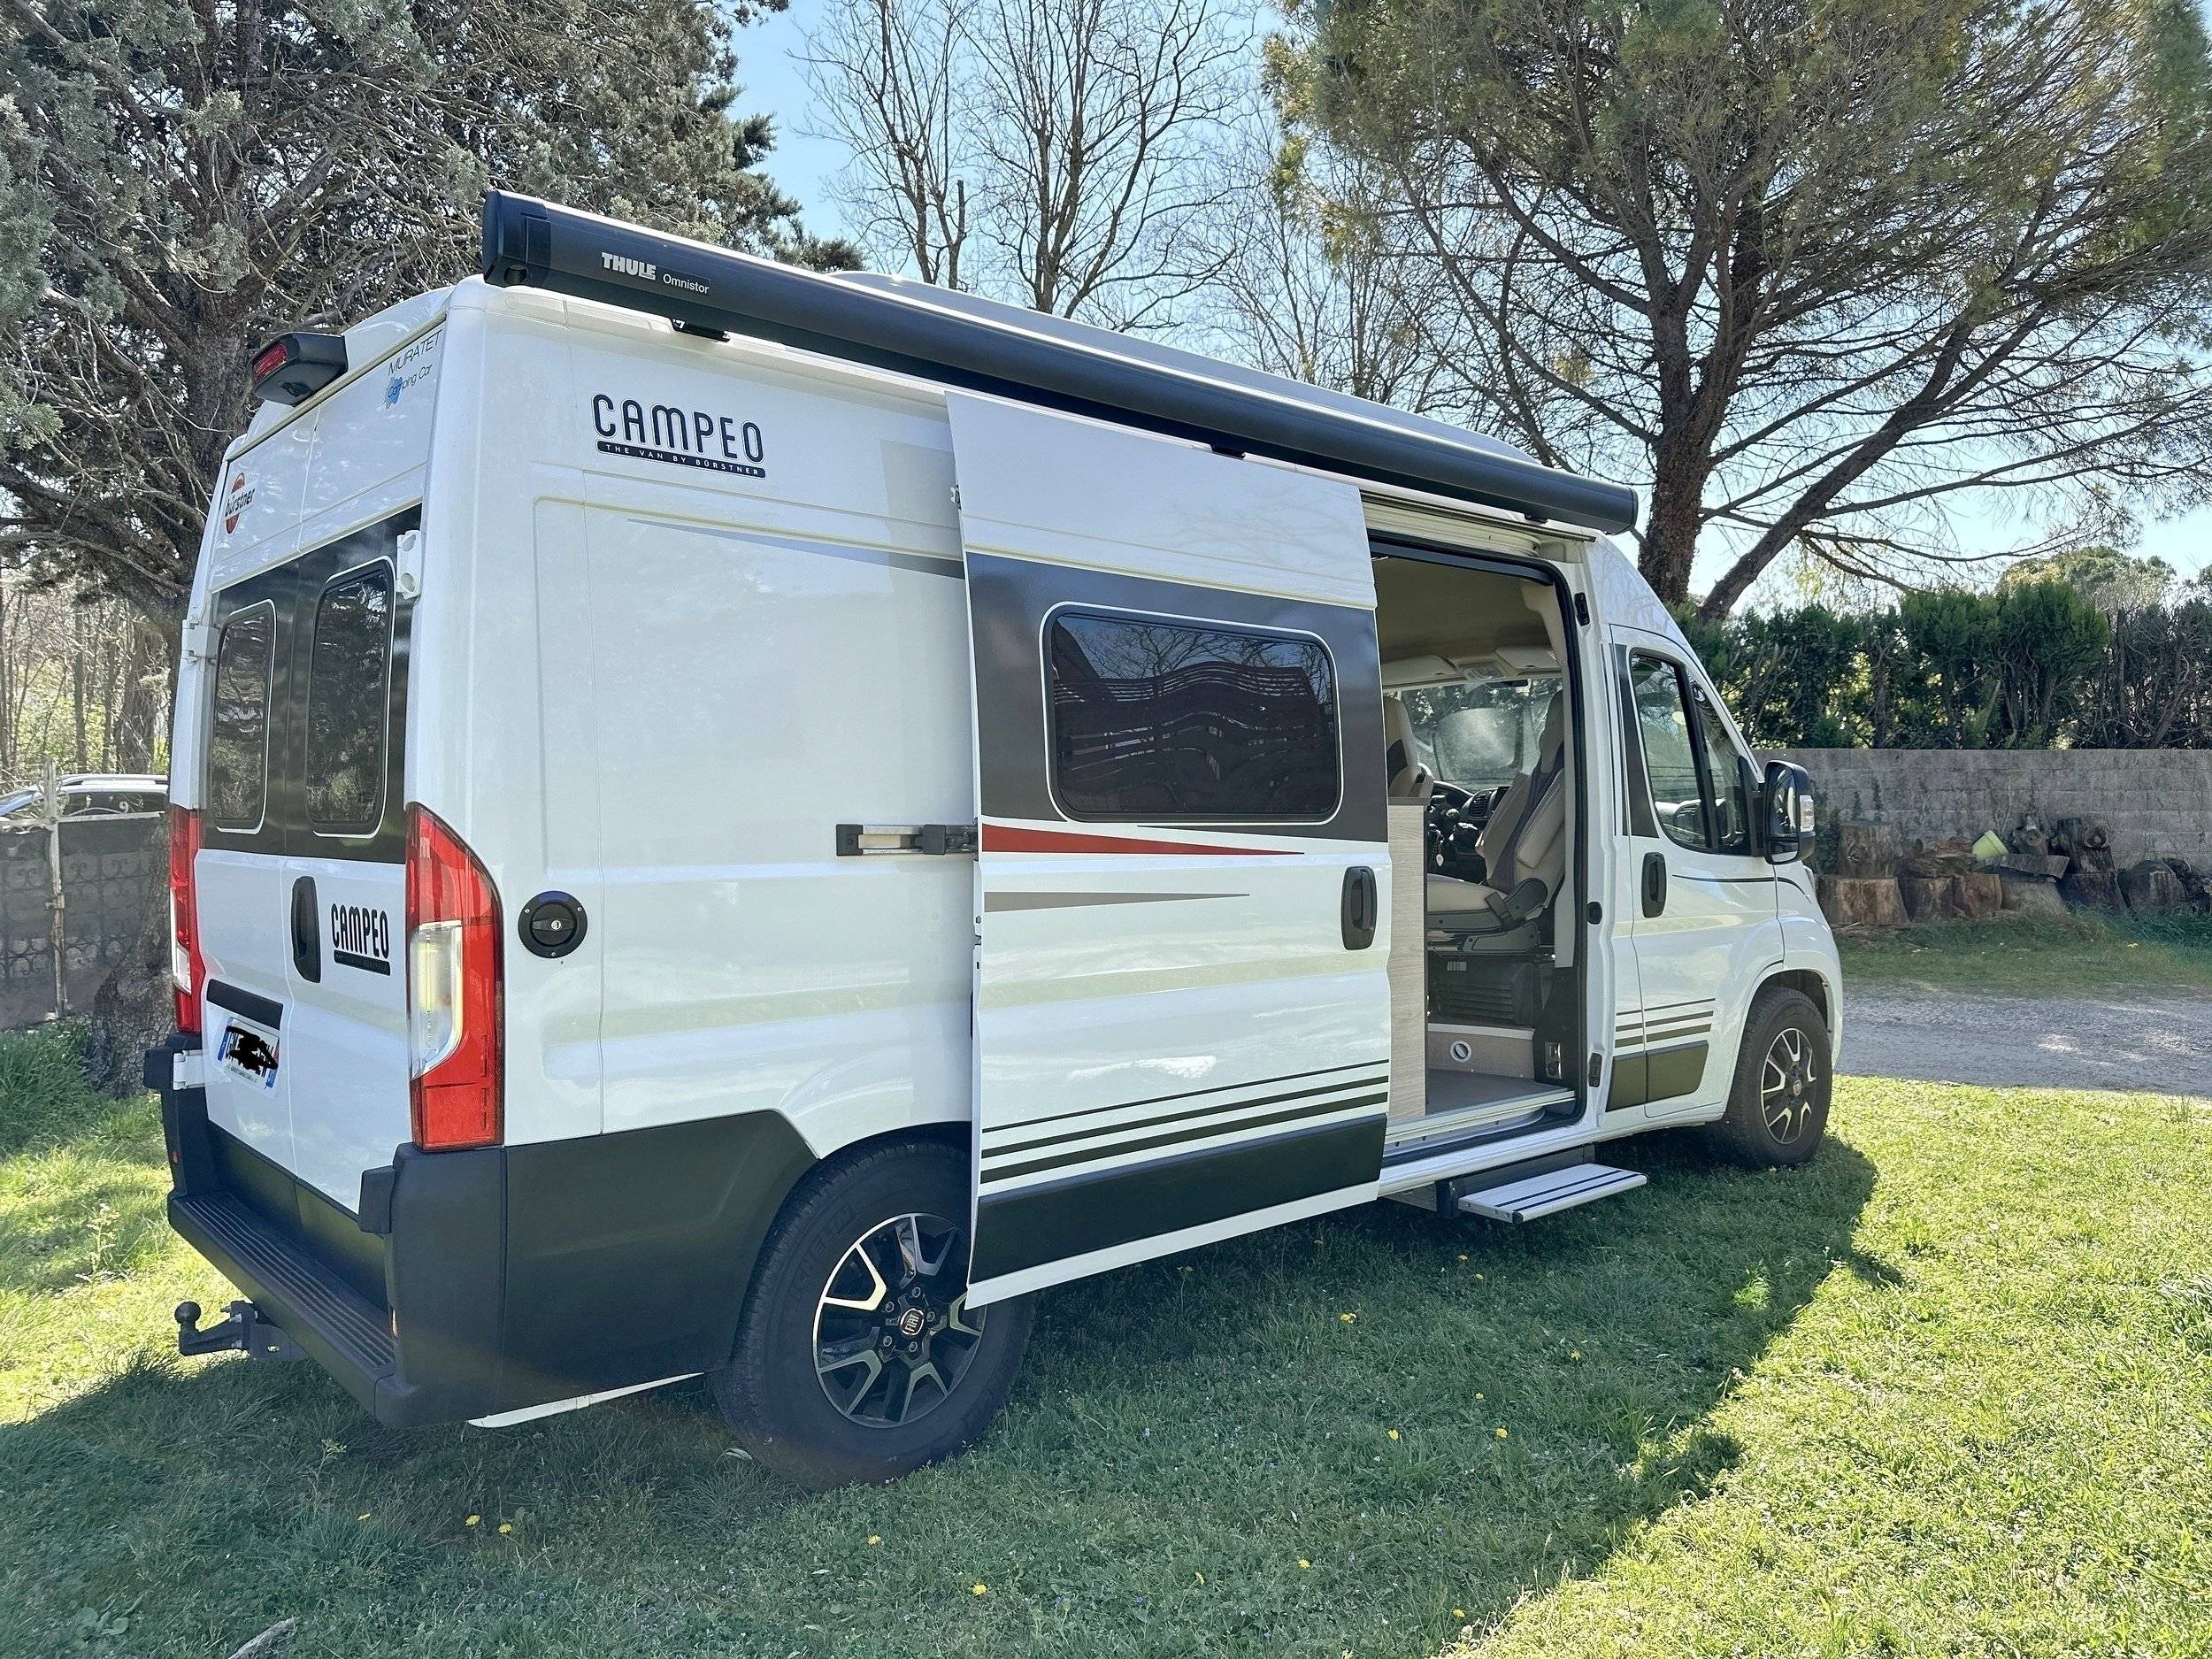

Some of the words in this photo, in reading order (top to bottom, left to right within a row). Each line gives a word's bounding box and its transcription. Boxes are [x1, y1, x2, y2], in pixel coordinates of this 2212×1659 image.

[602, 251, 657, 280] THULE
[663, 273, 710, 294] Omnistor
[388, 329, 443, 375] MURATET
[419, 364, 433, 380] Car
[592, 394, 764, 463] CAMPEO
[605, 444, 630, 455] THE
[639, 449, 664, 460] VAN
[672, 455, 687, 464] BY
[331, 902, 389, 960] CAMPEO
[904, 1313, 920, 1333] FIAT
